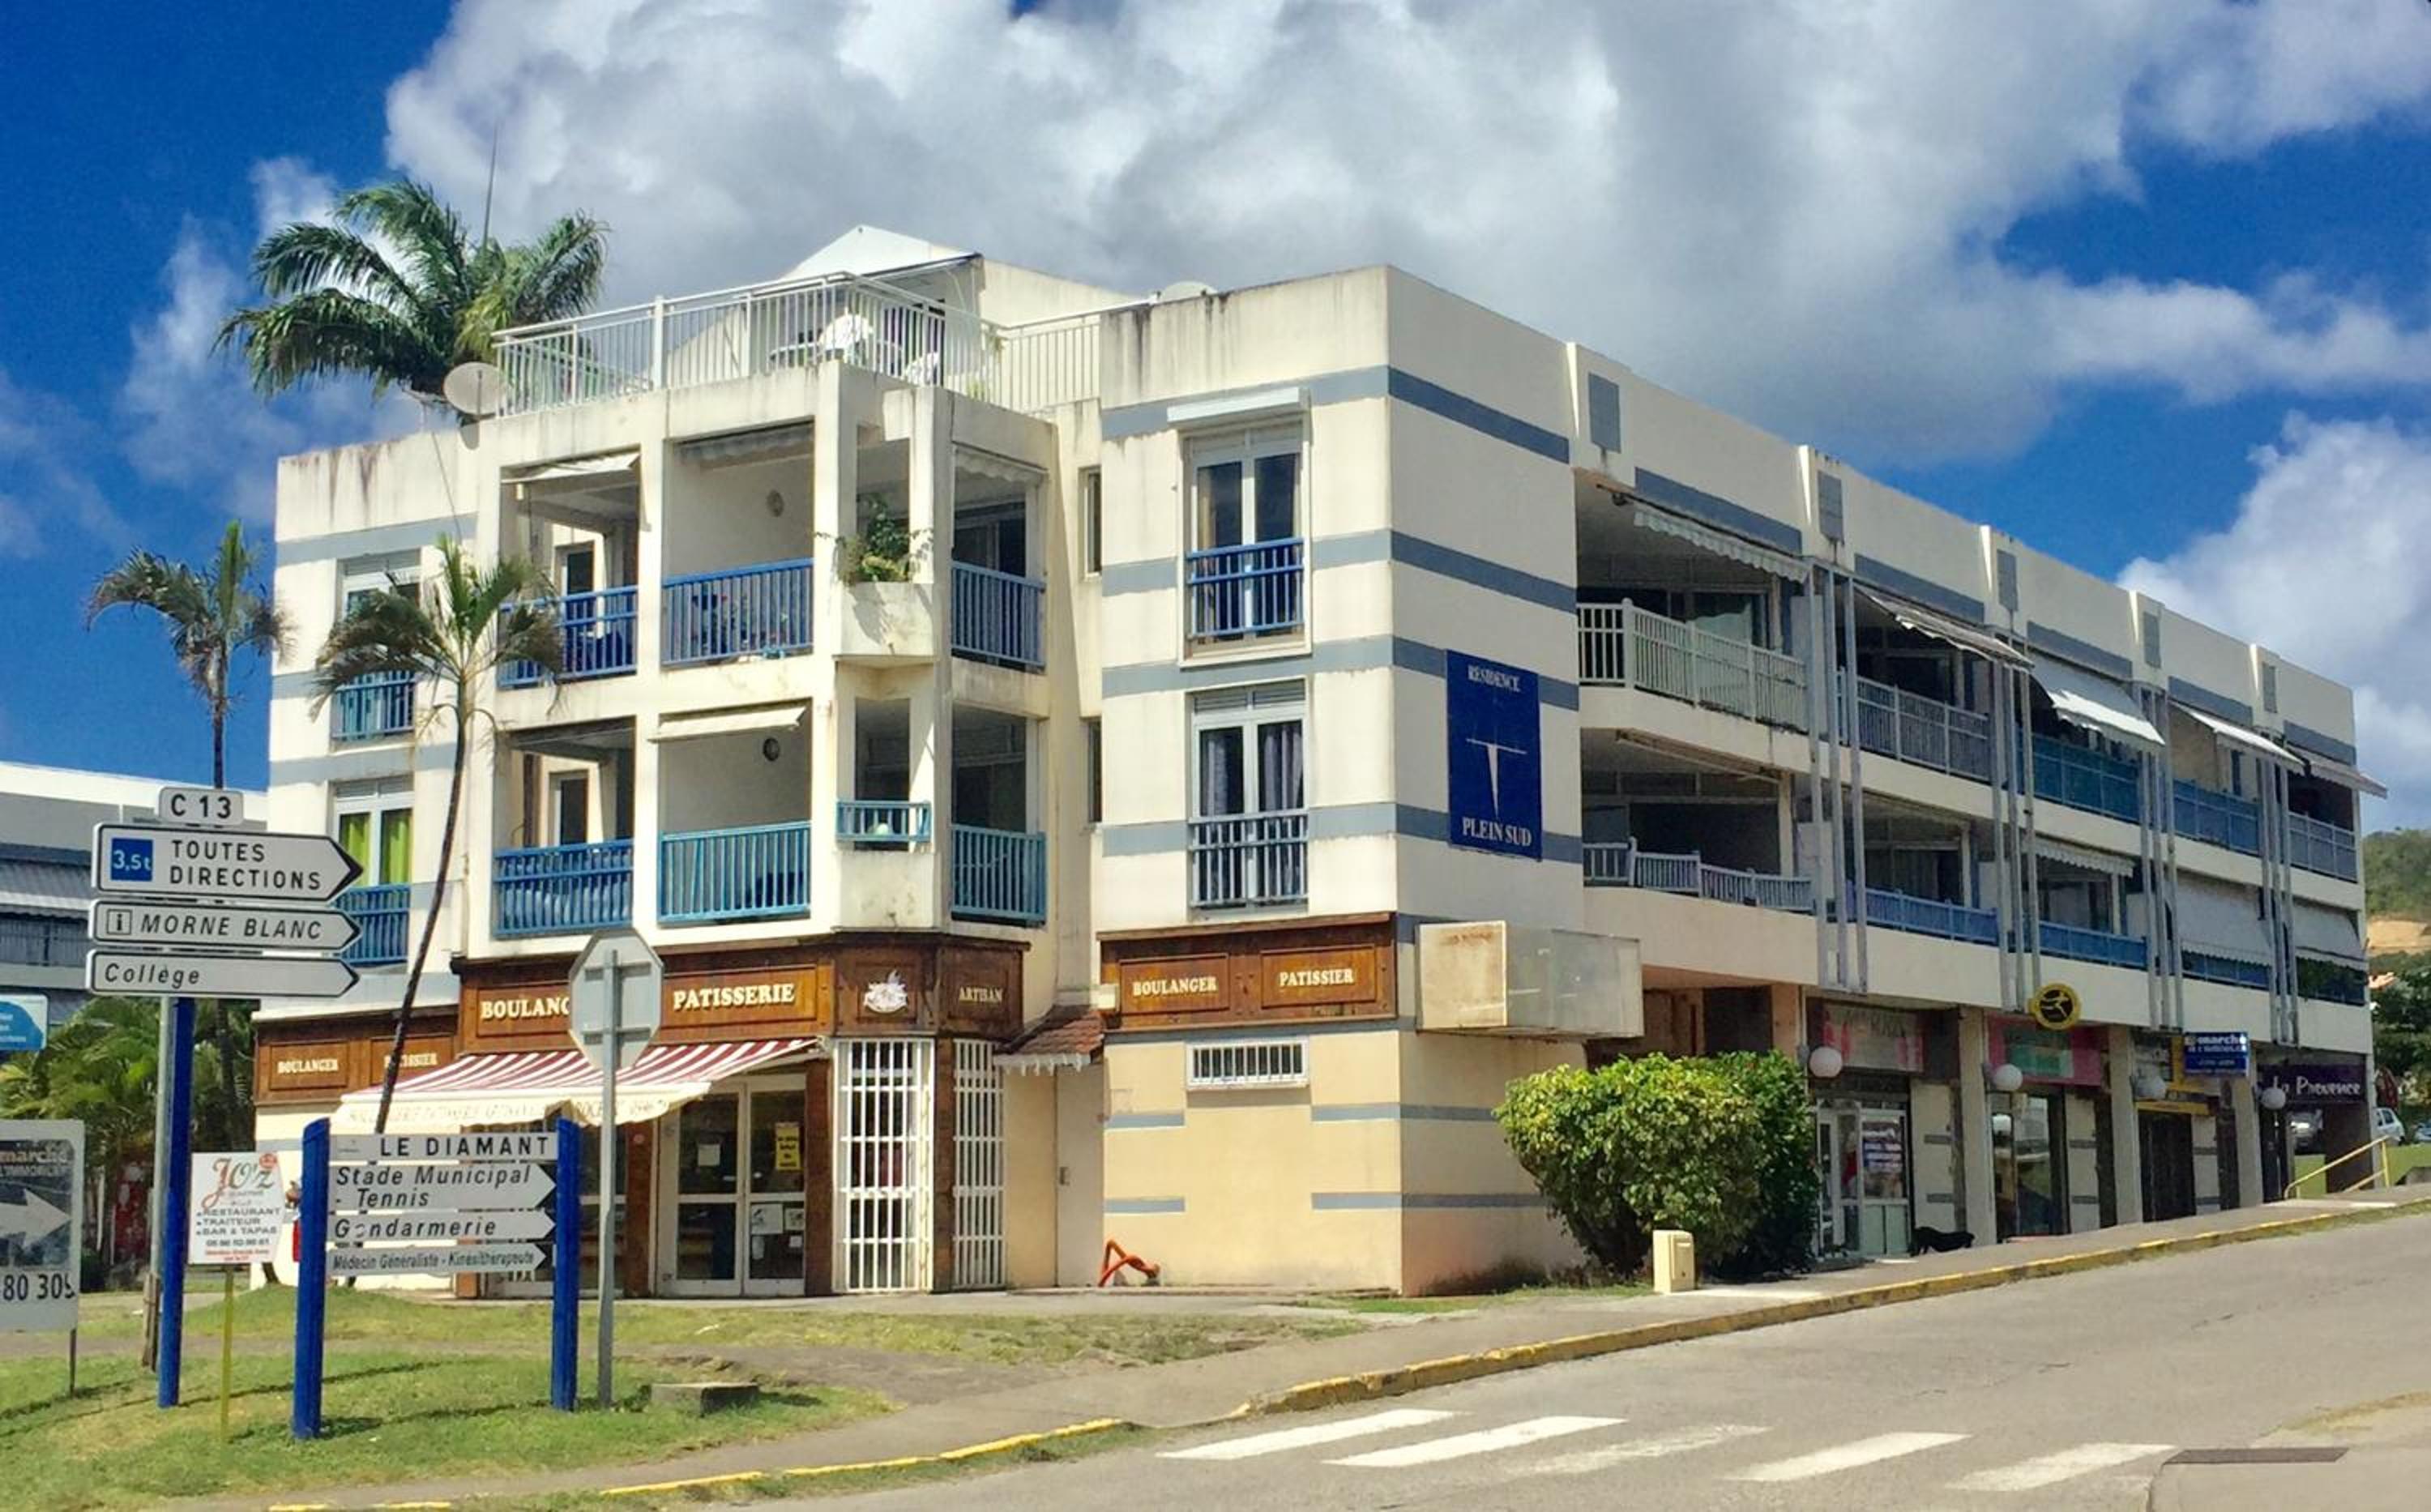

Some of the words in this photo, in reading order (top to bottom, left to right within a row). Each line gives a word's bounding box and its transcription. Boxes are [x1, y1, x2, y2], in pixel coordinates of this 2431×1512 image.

[171, 794, 186, 817] C
[199, 796, 232, 818] 13
[1462, 817, 1503, 842] PLEIN
[1506, 825, 1532, 847] SUD
[171, 839, 265, 861] TOUTES
[170, 866, 321, 890] DIRECTIONS
[141, 914, 230, 936] MORNE
[244, 922, 322, 940] BLANC
[105, 963, 200, 989] Collège
[1133, 976, 1218, 997] BOULANGER
[1279, 968, 1355, 987] PATISSIER
[673, 982, 795, 1011] PATISSERIE
[959, 986, 1003, 1003] ARTISAN
[380, 1138, 409, 1156] LE
[426, 1137, 549, 1156] DIAMANT
[336, 1167, 403, 1185] Stade
[414, 1165, 531, 1189] Municipal
[357, 1188, 429, 1208] Tennis
[334, 1217, 496, 1239] Gendarmerie
